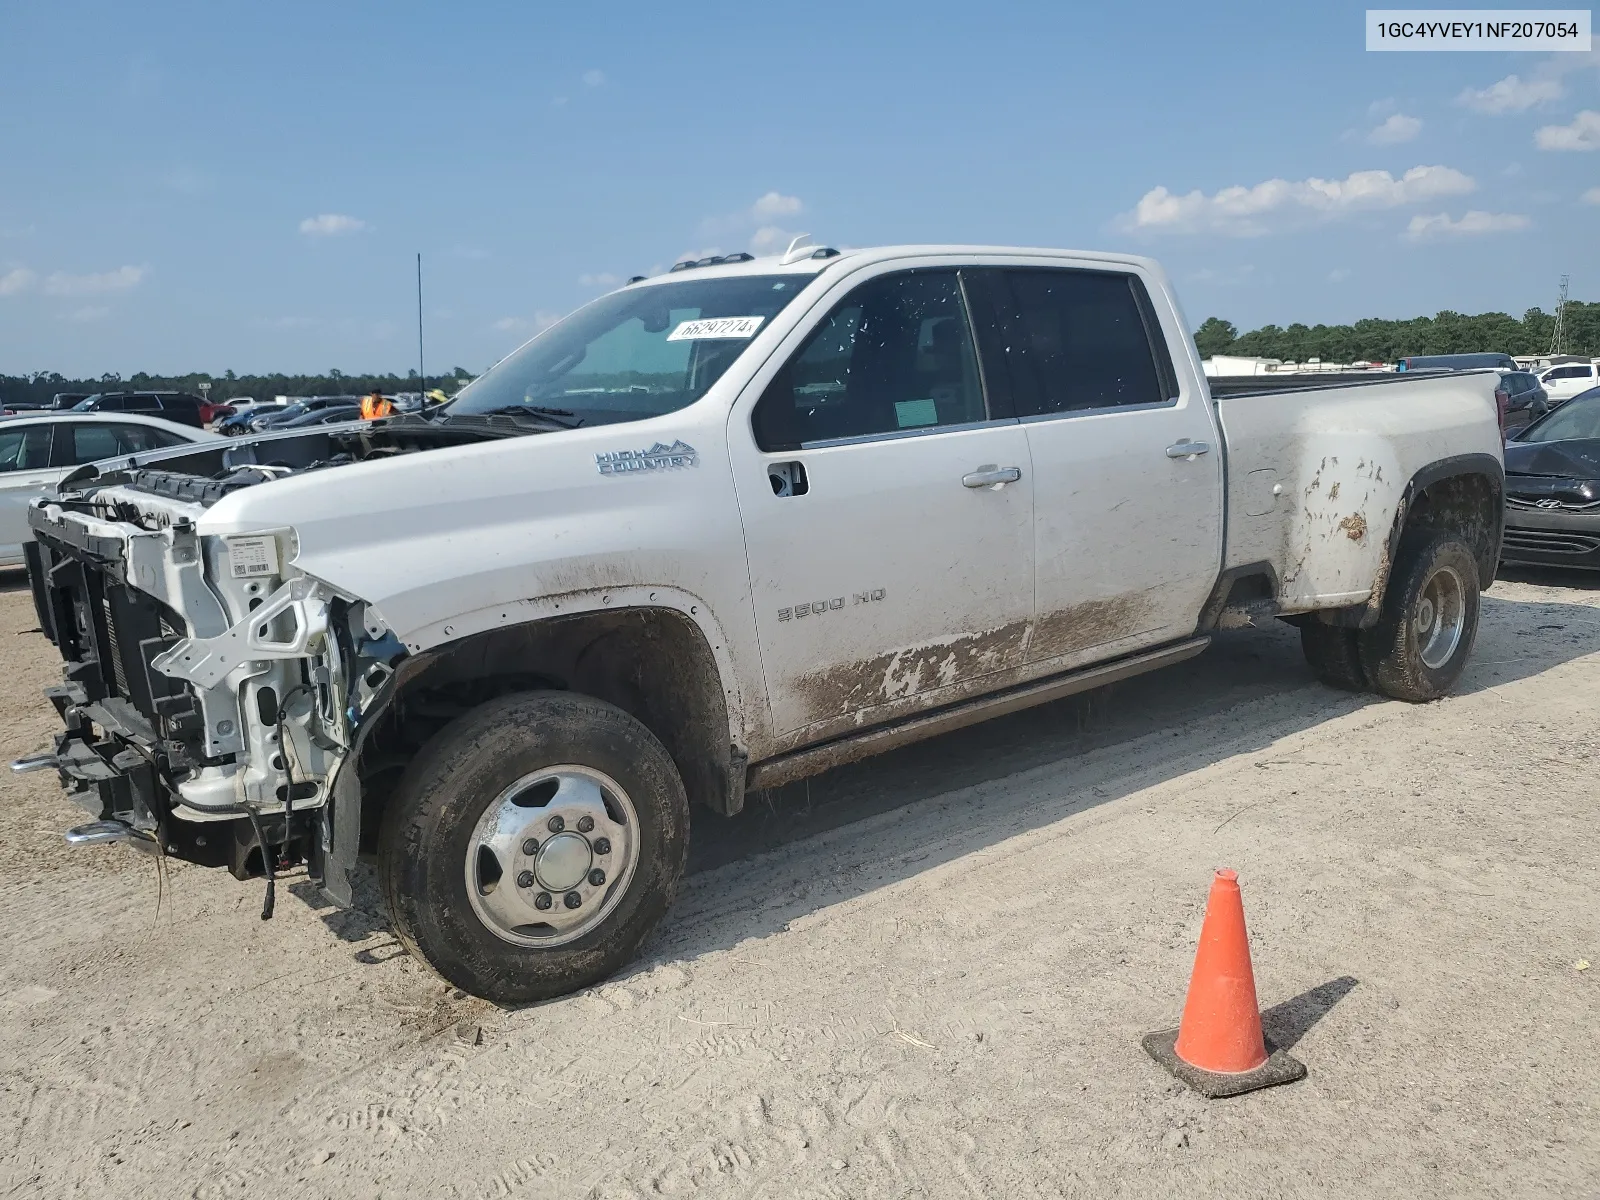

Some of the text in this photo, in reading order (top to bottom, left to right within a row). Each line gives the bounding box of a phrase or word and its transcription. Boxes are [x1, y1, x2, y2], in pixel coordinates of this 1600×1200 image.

[594, 450, 646, 463] HIGH
[597, 455, 696, 474] COUNTRY
[777, 588, 887, 622] 3500 HD
